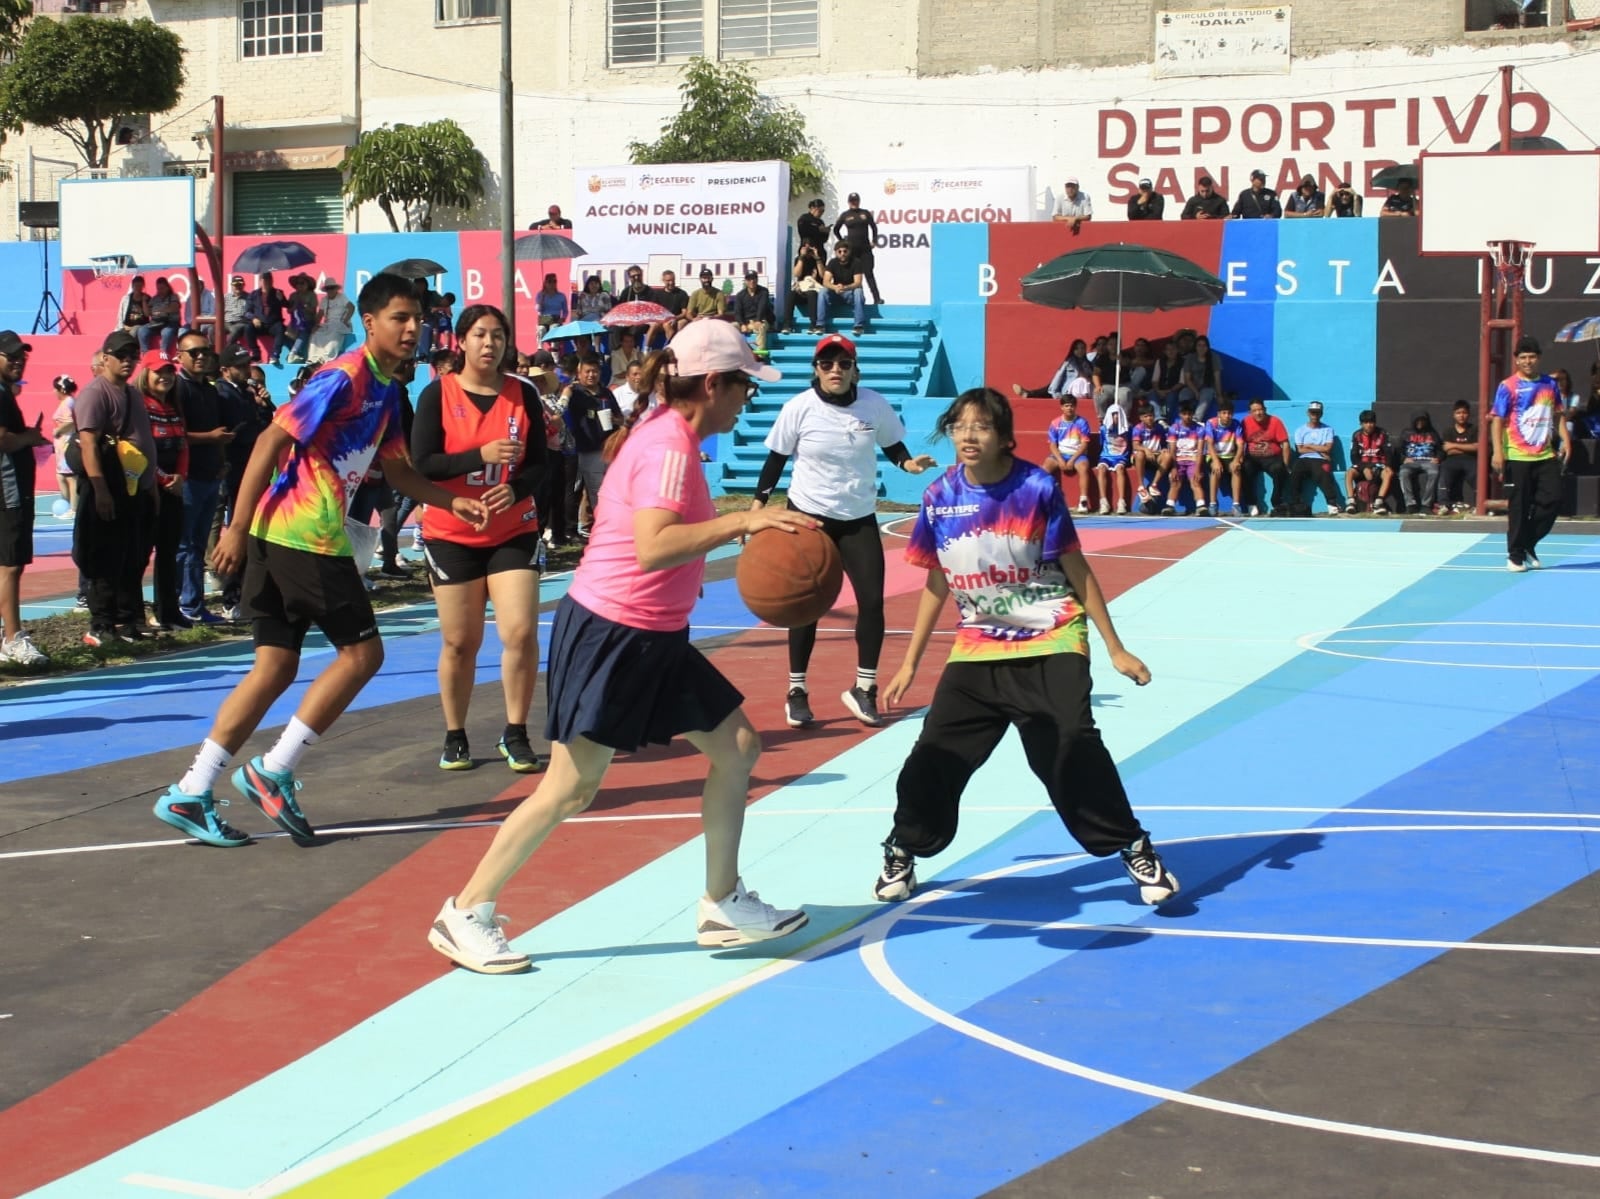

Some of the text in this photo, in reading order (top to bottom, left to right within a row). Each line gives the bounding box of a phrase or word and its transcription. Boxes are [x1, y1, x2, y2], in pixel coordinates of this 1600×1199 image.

[1175, 9, 1273, 20] CIRCULO DE ESTUDIO
[1098, 91, 1550, 158] DEPORTIVO
[654, 176, 696, 184] ECATEPEC
[707, 175, 767, 186] PRESIDENCIA
[1107, 162, 1230, 205] SAN
[585, 200, 766, 217] ACCIÓN DE GOBIERNO
[872, 203, 1012, 225] AUGURACIÓN
[627, 222, 717, 235] MUNICIPAL
[1226, 258, 1406, 297] ESTA
[936, 504, 980, 515] ECATEPEC
